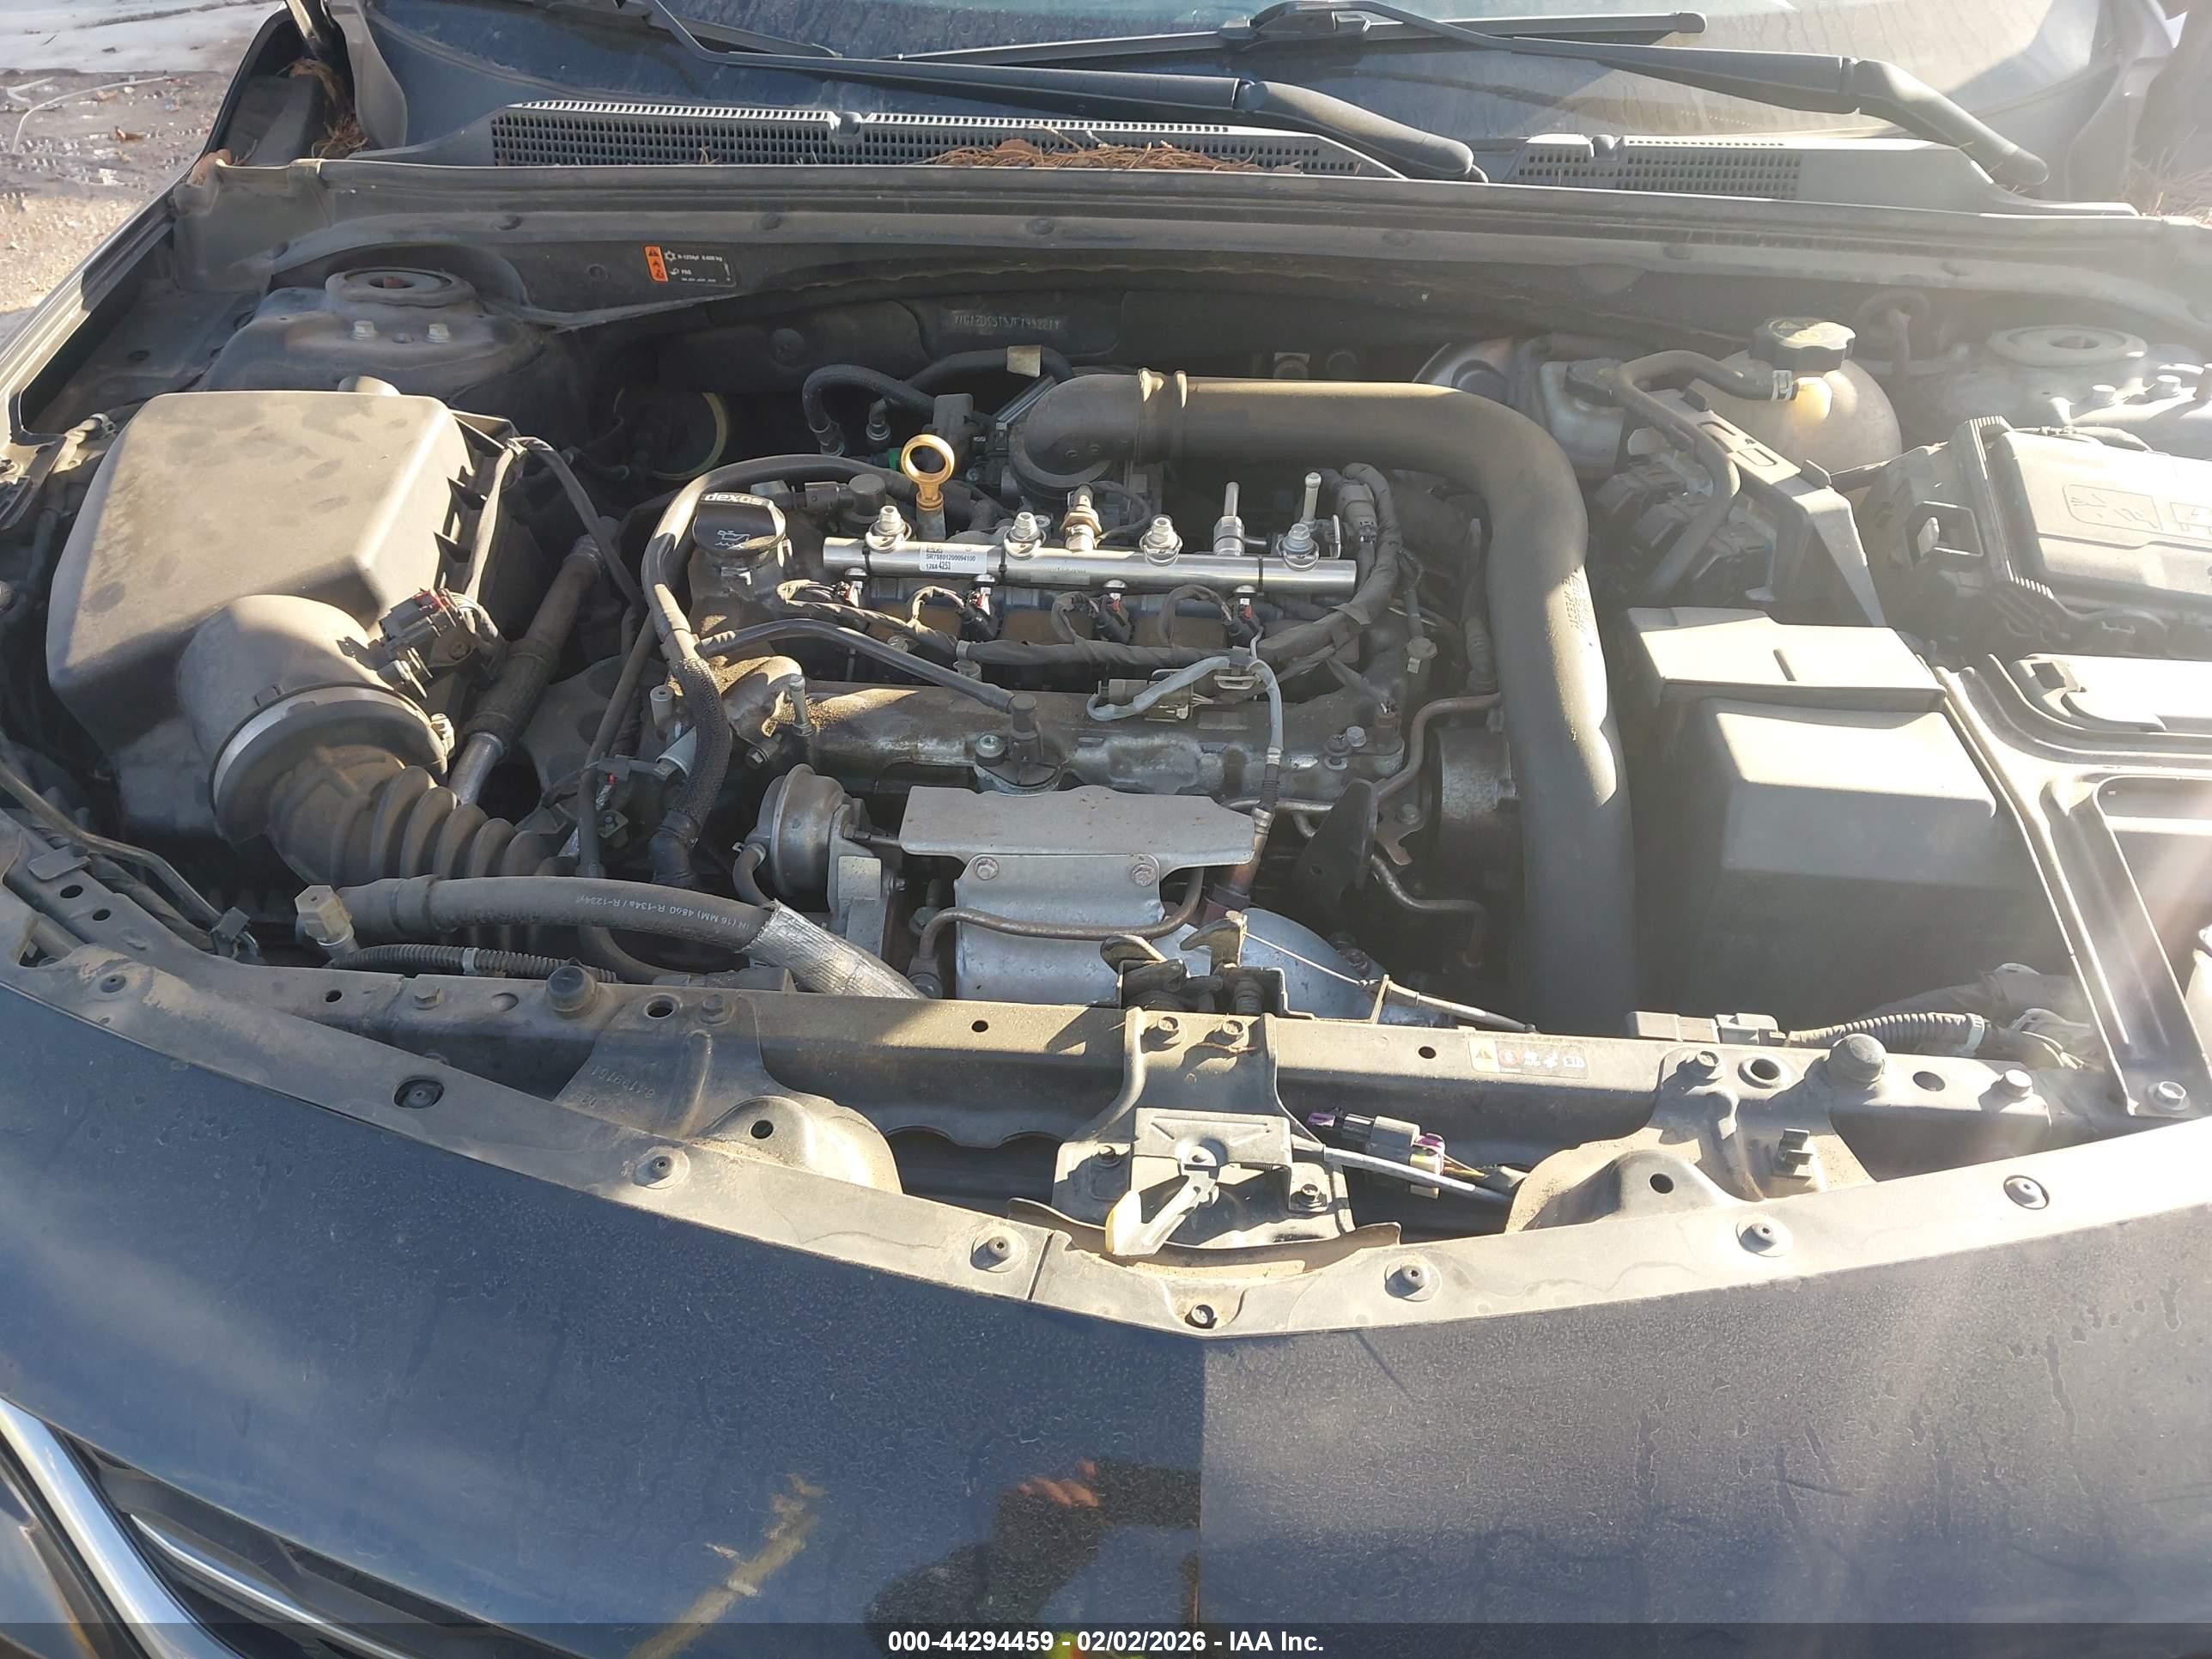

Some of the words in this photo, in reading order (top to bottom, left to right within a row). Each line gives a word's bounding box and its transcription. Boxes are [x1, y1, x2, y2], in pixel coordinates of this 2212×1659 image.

[704, 493, 764, 506] dexos
[629, 900, 665, 913] R-134a
[696, 911, 719, 923] MM)
